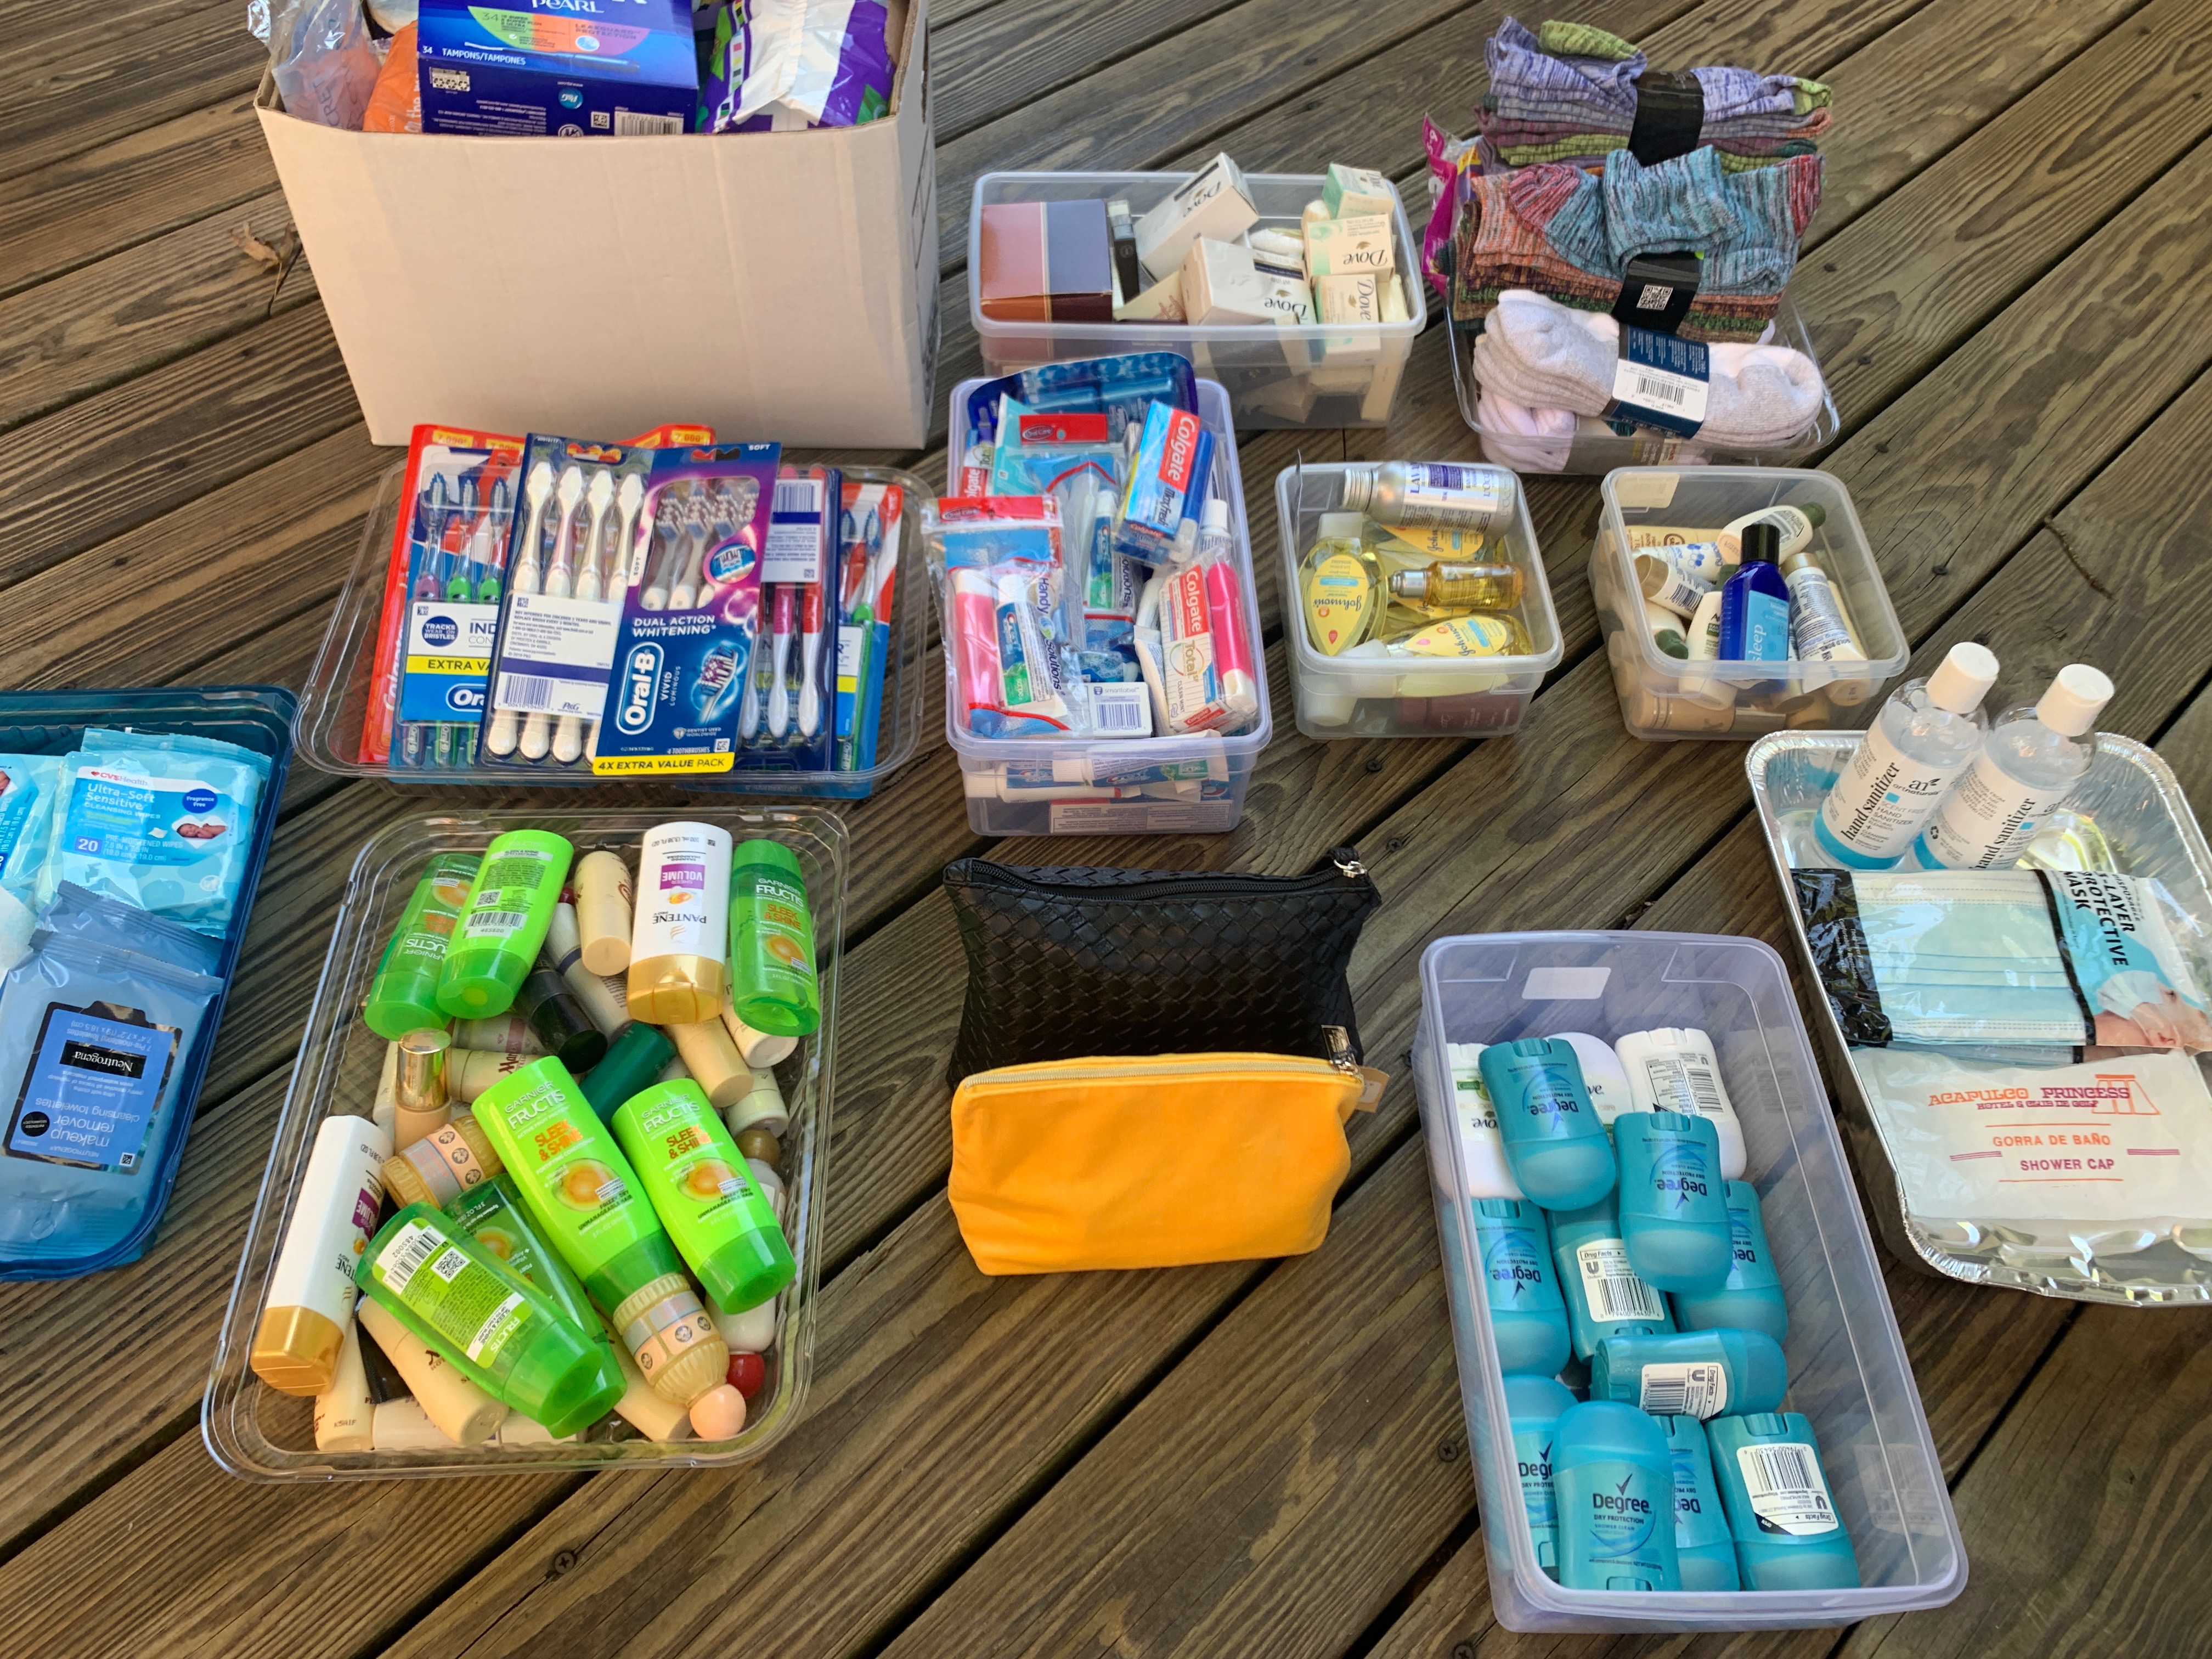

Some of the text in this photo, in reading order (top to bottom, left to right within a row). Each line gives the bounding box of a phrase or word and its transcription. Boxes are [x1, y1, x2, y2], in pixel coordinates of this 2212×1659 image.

[422, 46, 526, 66] 34 TAMPONS/TAMPONES
[1181, 180, 1222, 218] Dove
[1343, 249, 1388, 267] Dove
[1264, 297, 1308, 321] Dove
[1357, 279, 1376, 321] Dove
[1170, 416, 1194, 482] Colgate
[1037, 577, 1050, 615] Handy
[1186, 571, 1203, 633] Colgate
[1313, 595, 1362, 611] Johnson's
[634, 615, 715, 627] DUAL ACTION
[428, 659, 472, 670] EXTRA
[1043, 637, 1062, 690] Solutions
[1184, 639, 1198, 676] Total
[624, 652, 656, 725] Oral-B
[660, 672, 672, 701] VIVID
[599, 758, 725, 770] 4X EXTRA VALUE PACK
[88, 783, 155, 803] Ultra-Soft
[1893, 783, 1942, 796] artnaturals
[85, 792, 144, 810] Sensitive
[1841, 761, 1900, 842] hand sanitizer
[1881, 801, 1906, 813] SCENT
[84, 803, 161, 819] CLEANSING WIPES
[1873, 812, 1914, 825] SANITIZER
[1877, 806, 1902, 818] HAND
[11, 816, 21, 827] 19.0
[1994, 798, 2036, 845] sanitizer
[78, 838, 99, 852] 20
[661, 871, 703, 882] VOLUME
[756, 884, 804, 907] FRUCTIS
[758, 878, 802, 897] GARNIER
[652, 913, 707, 924] PANTENE
[764, 911, 802, 930] & SHINE
[768, 904, 798, 919] SLEEK
[66, 1028, 99, 1041] Towelettes
[101, 1035, 146, 1051] Pre-moistened
[72, 1051, 133, 1072] Neutrogena
[88, 1076, 119, 1085] waterproof
[504, 1080, 555, 1114] GARNIER
[1928, 1086, 2130, 1107] ACAPULCO PRINCESS
[1977, 1101, 2014, 1110] HOTEL
[2025, 1100, 2053, 1108] CLUB
[2072, 1099, 2100, 1108] GOLF
[35, 1097, 140, 1123] cleansing towelettes
[507, 1088, 566, 1130] FRUCTIS
[641, 1093, 690, 1119] GARNIER
[1530, 1099, 1579, 1116] Degree
[54, 1114, 115, 1133] remover
[642, 1101, 700, 1133] FRUCTIS
[1471, 1118, 1498, 1129] ove
[50, 1127, 110, 1148] makeup
[534, 1118, 572, 1147] SLEEK
[666, 1124, 704, 1147] SLEEK
[1993, 1132, 2112, 1148] GORRA DE BAÑO
[538, 1149, 550, 1161] &
[668, 1148, 679, 1160] &
[1662, 1169, 1691, 1178] PROTECTION
[2020, 1158, 2114, 1171] SHOWER CAP
[1659, 1178, 1708, 1197] Degree
[1585, 1250, 1597, 1259] Drug
[1496, 1269, 1542, 1284] Degree
[487, 1315, 522, 1354] FRUCTIS
[1592, 1493, 1650, 1514] Degree
[1608, 1515, 1645, 1525] PROTECTION
[1820, 1513, 1832, 1521] Drug
